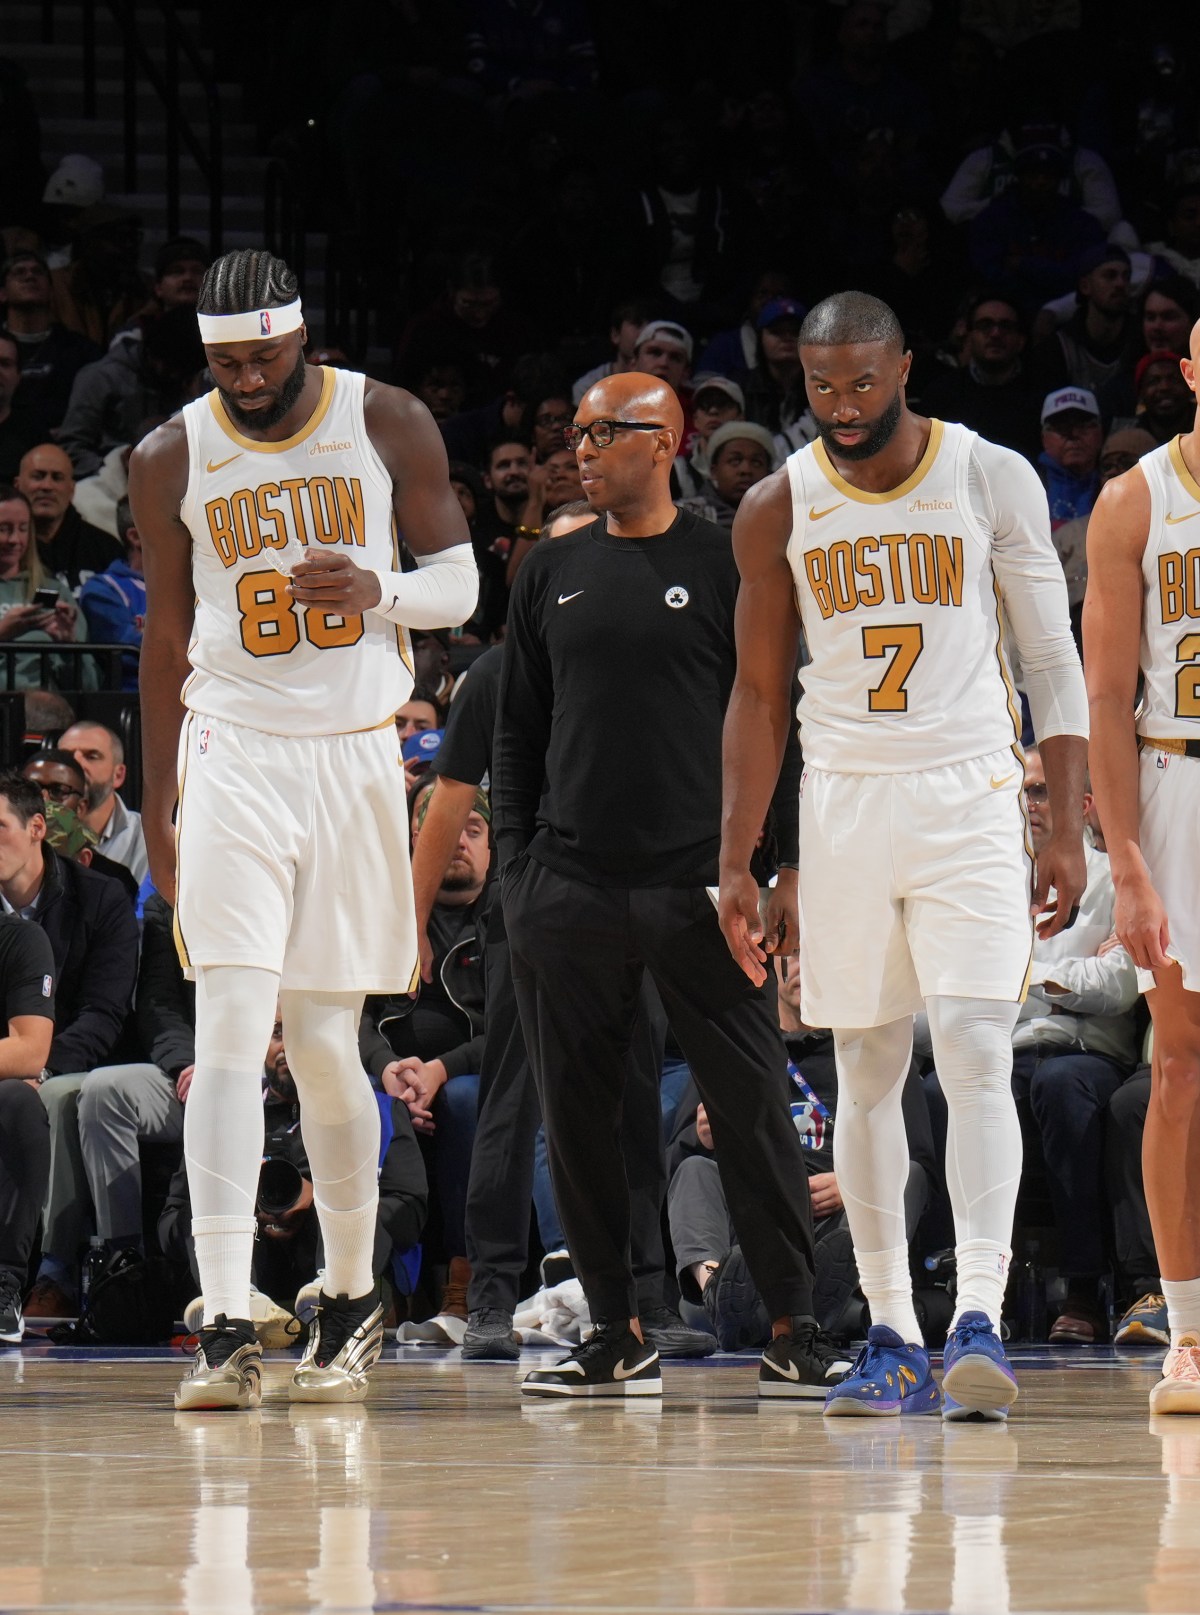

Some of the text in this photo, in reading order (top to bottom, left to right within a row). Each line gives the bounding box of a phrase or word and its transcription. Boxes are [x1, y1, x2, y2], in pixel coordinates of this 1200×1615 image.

[309, 440, 353, 456] Amica
[205, 476, 366, 569] BOSTON
[909, 499, 953, 513] Amica
[803, 533, 964, 621] BOSTON
[861, 623, 924, 712] 7
